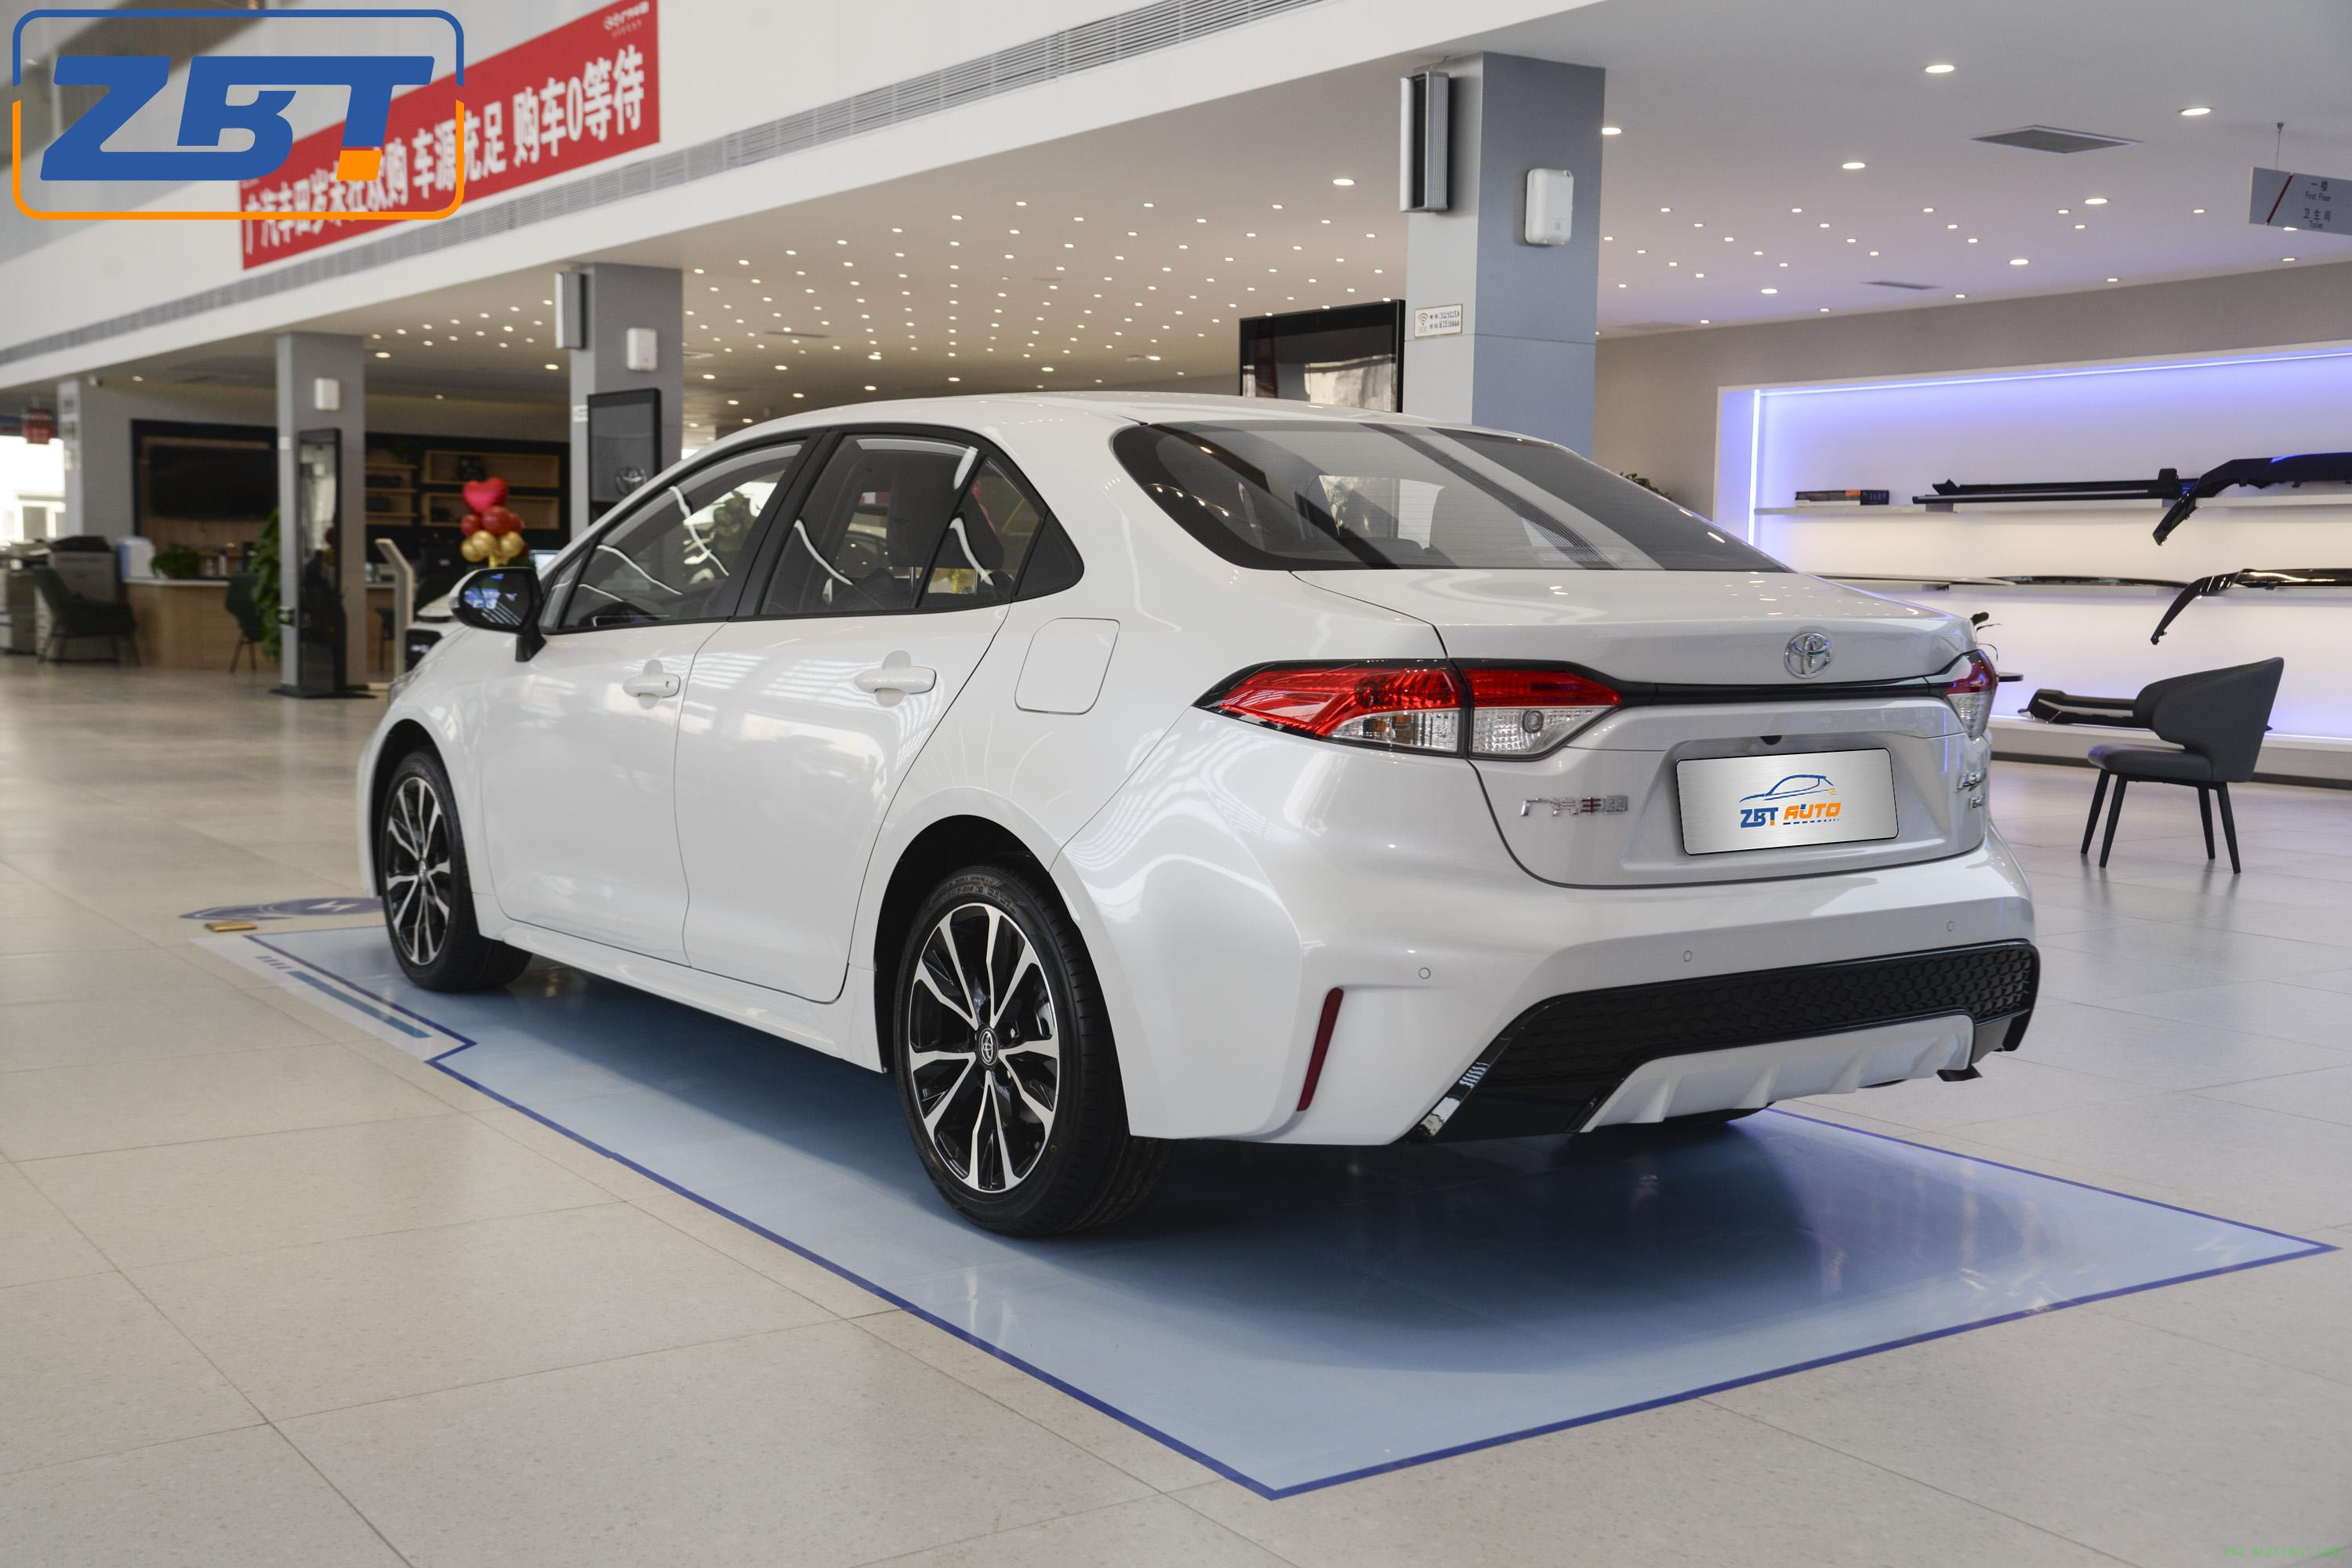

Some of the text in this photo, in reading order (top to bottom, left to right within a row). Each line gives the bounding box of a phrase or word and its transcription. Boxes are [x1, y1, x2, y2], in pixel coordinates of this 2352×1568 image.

[412, 100, 506, 198] 车源充足
[513, 44, 644, 167] 购车0等待
[2305, 191, 2332, 201] First Floor
[1520, 795, 1628, 816] 广汽丰田
[1740, 802, 1842, 828] ZBT AUTO
